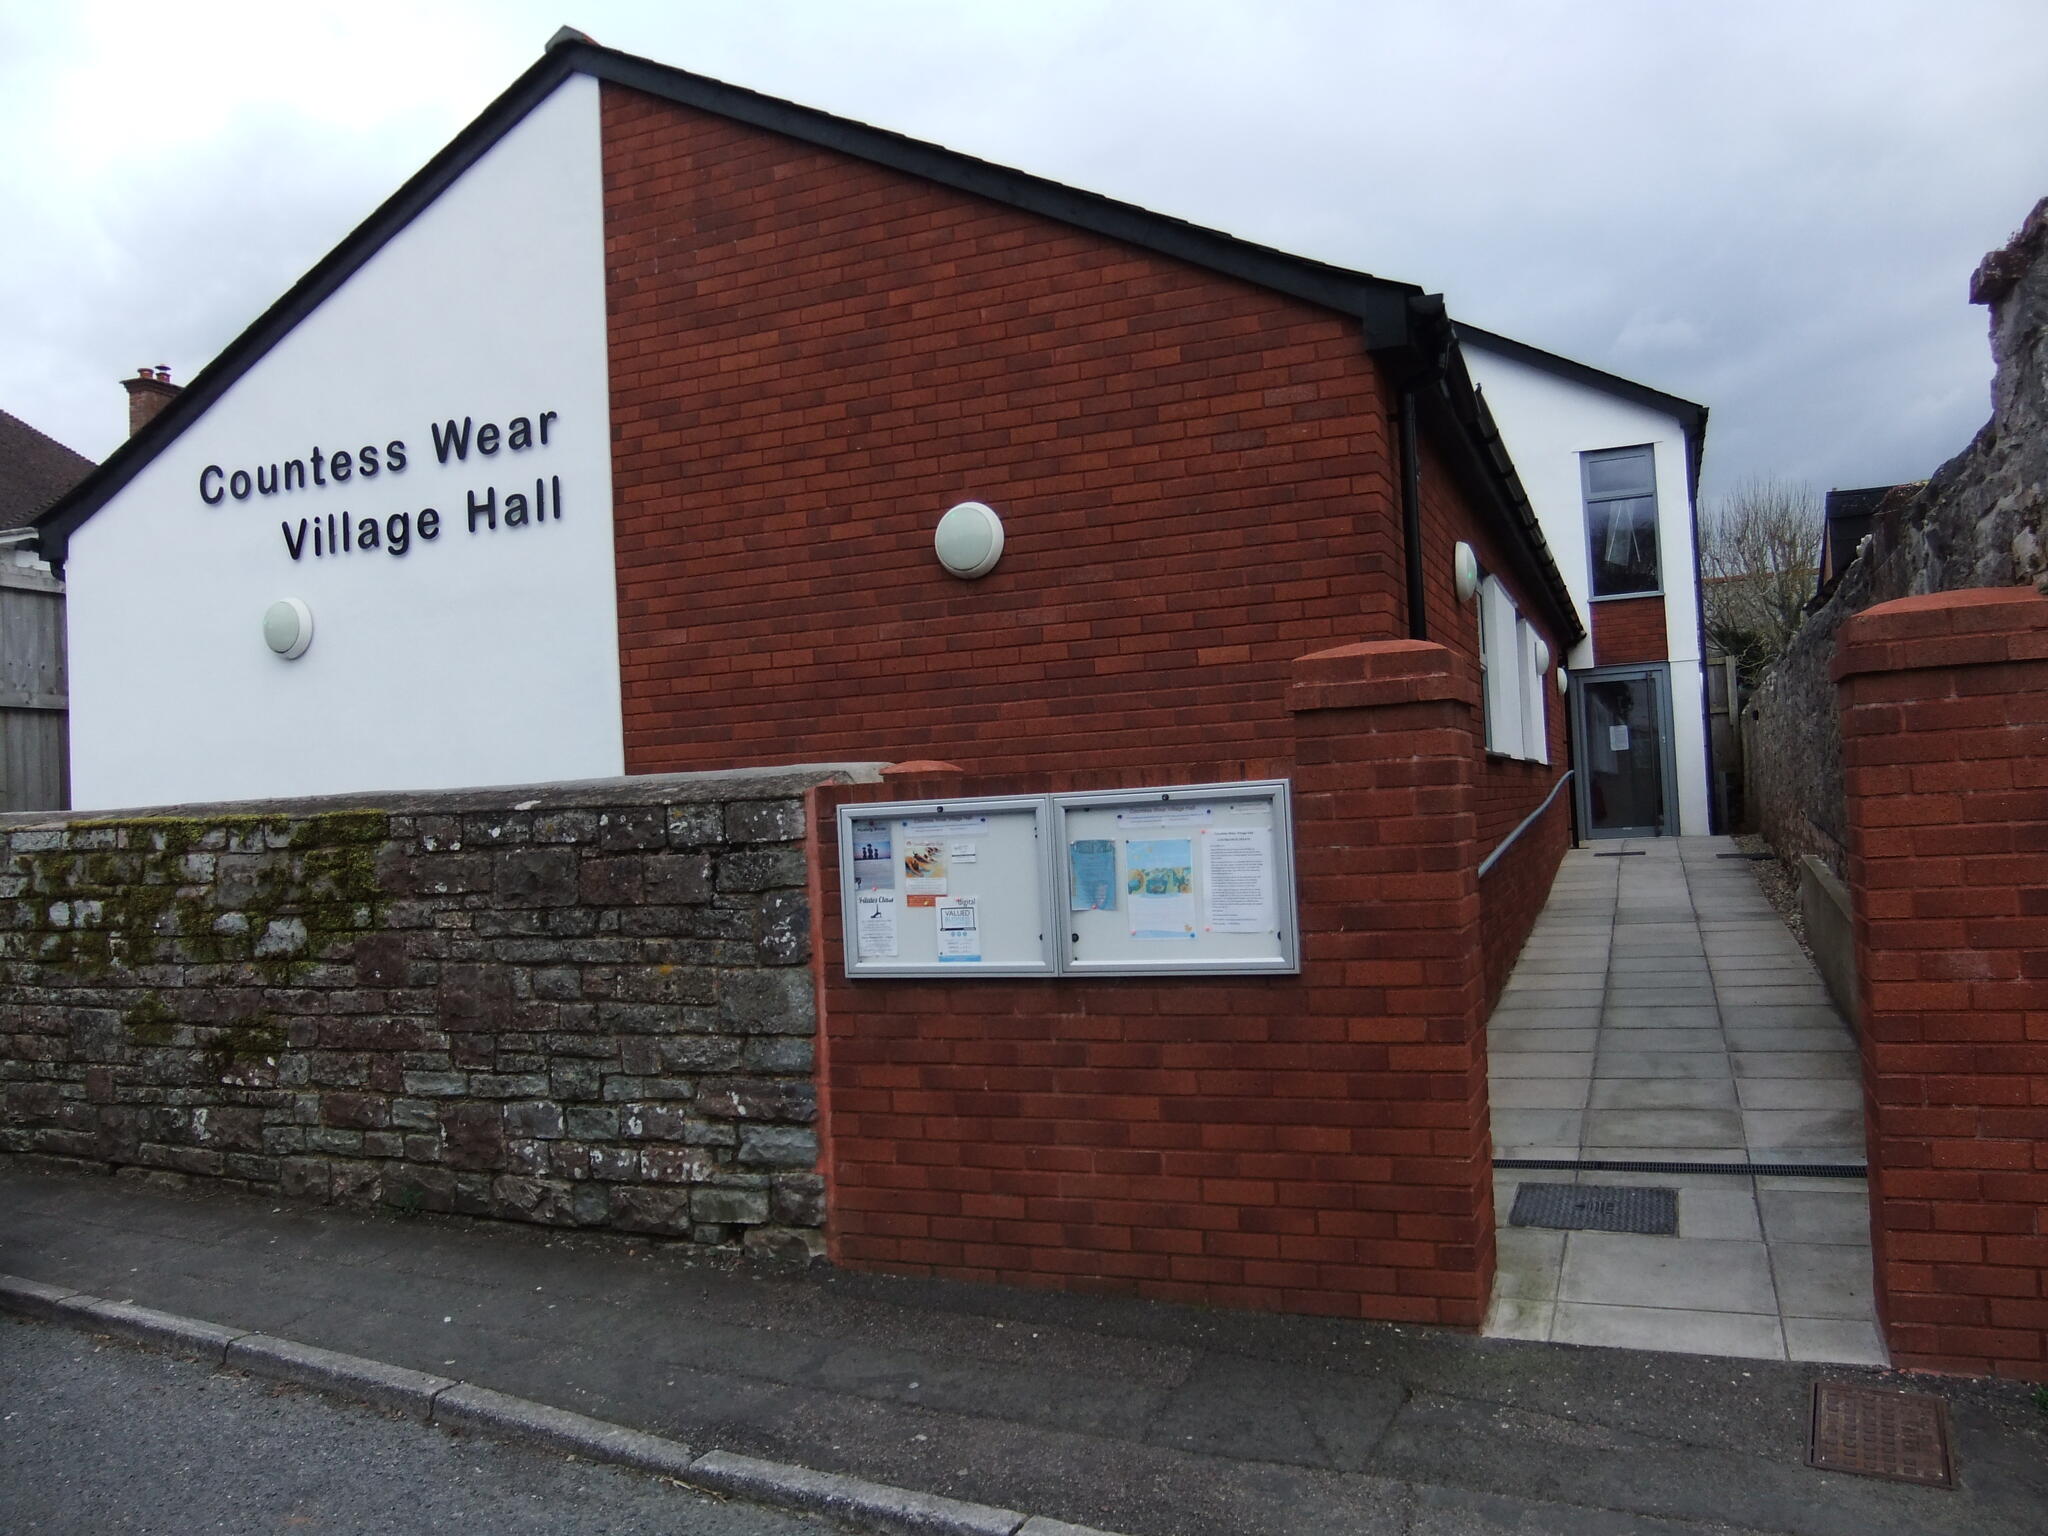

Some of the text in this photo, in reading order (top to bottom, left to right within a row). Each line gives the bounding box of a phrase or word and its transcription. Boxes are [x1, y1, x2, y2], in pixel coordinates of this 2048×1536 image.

[199, 411, 558, 505] Countess Wear
[282, 475, 561, 561] Village Hall
